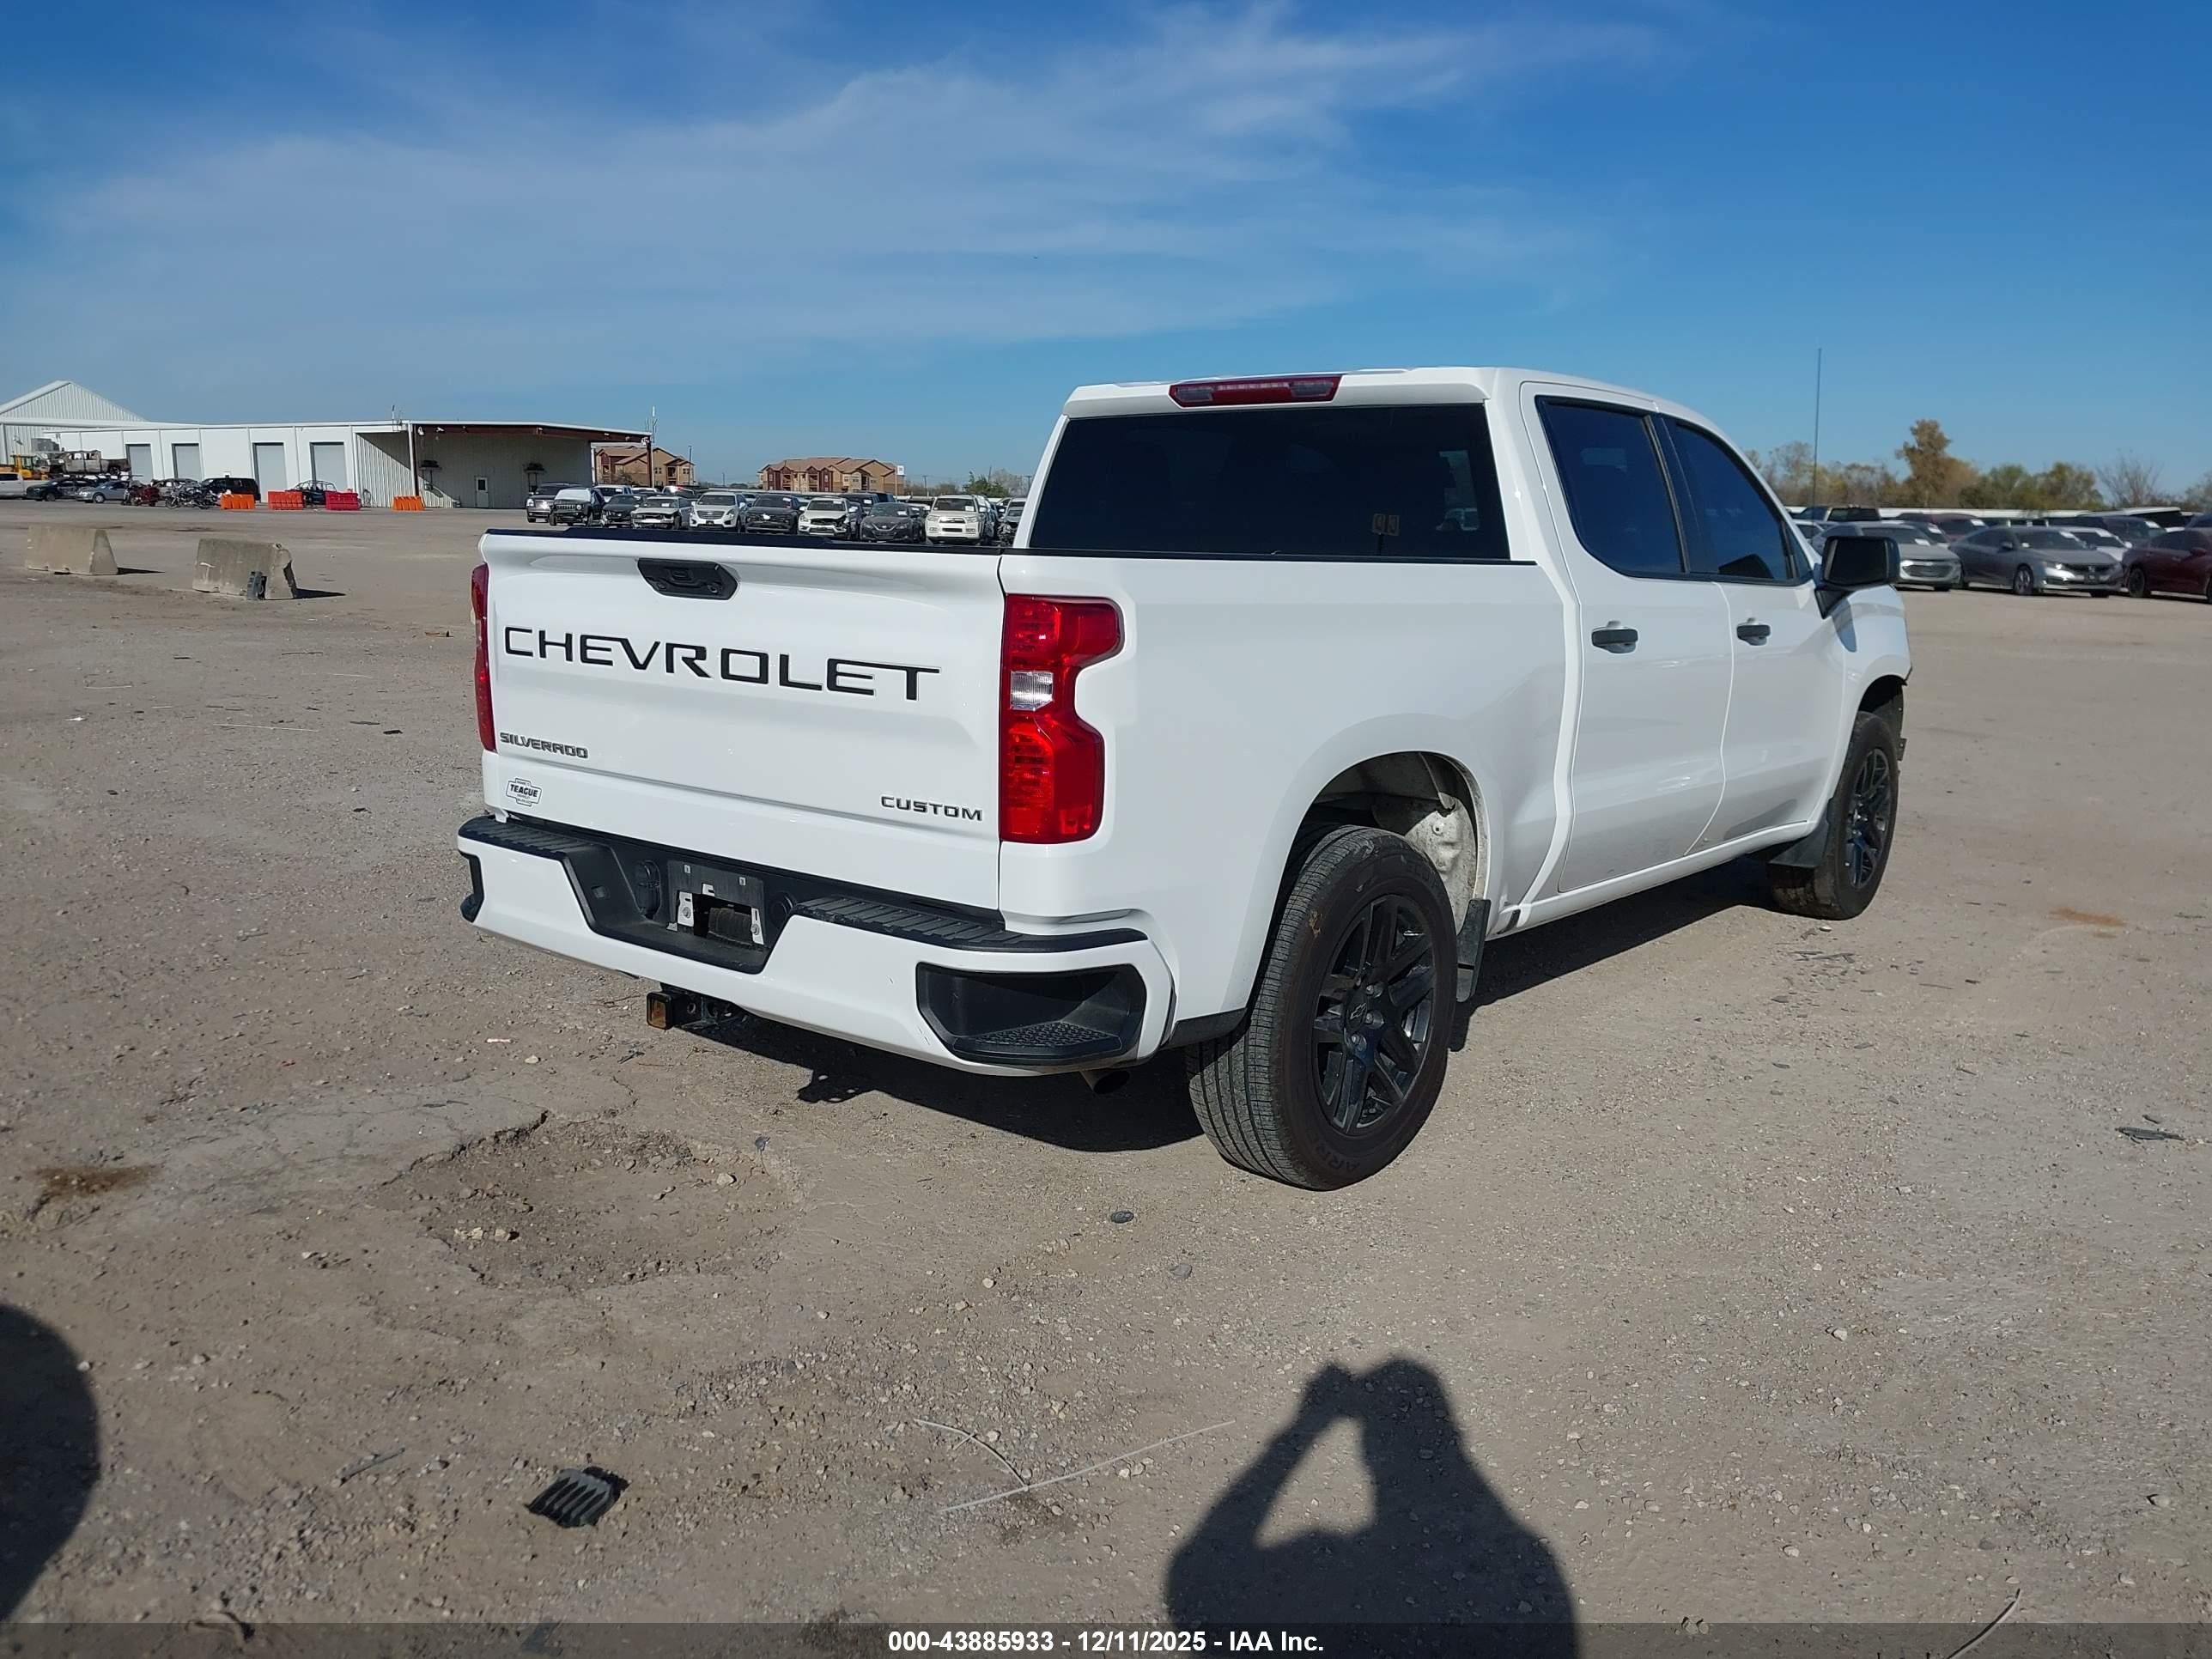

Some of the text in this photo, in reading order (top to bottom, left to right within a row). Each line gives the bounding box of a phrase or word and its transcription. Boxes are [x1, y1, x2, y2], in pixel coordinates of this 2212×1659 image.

[505, 626, 941, 701] CHEVROLET
[500, 732, 588, 759] SILVERADO
[510, 783, 538, 798] TEAGUE
[881, 796, 983, 822] CUSTOM
